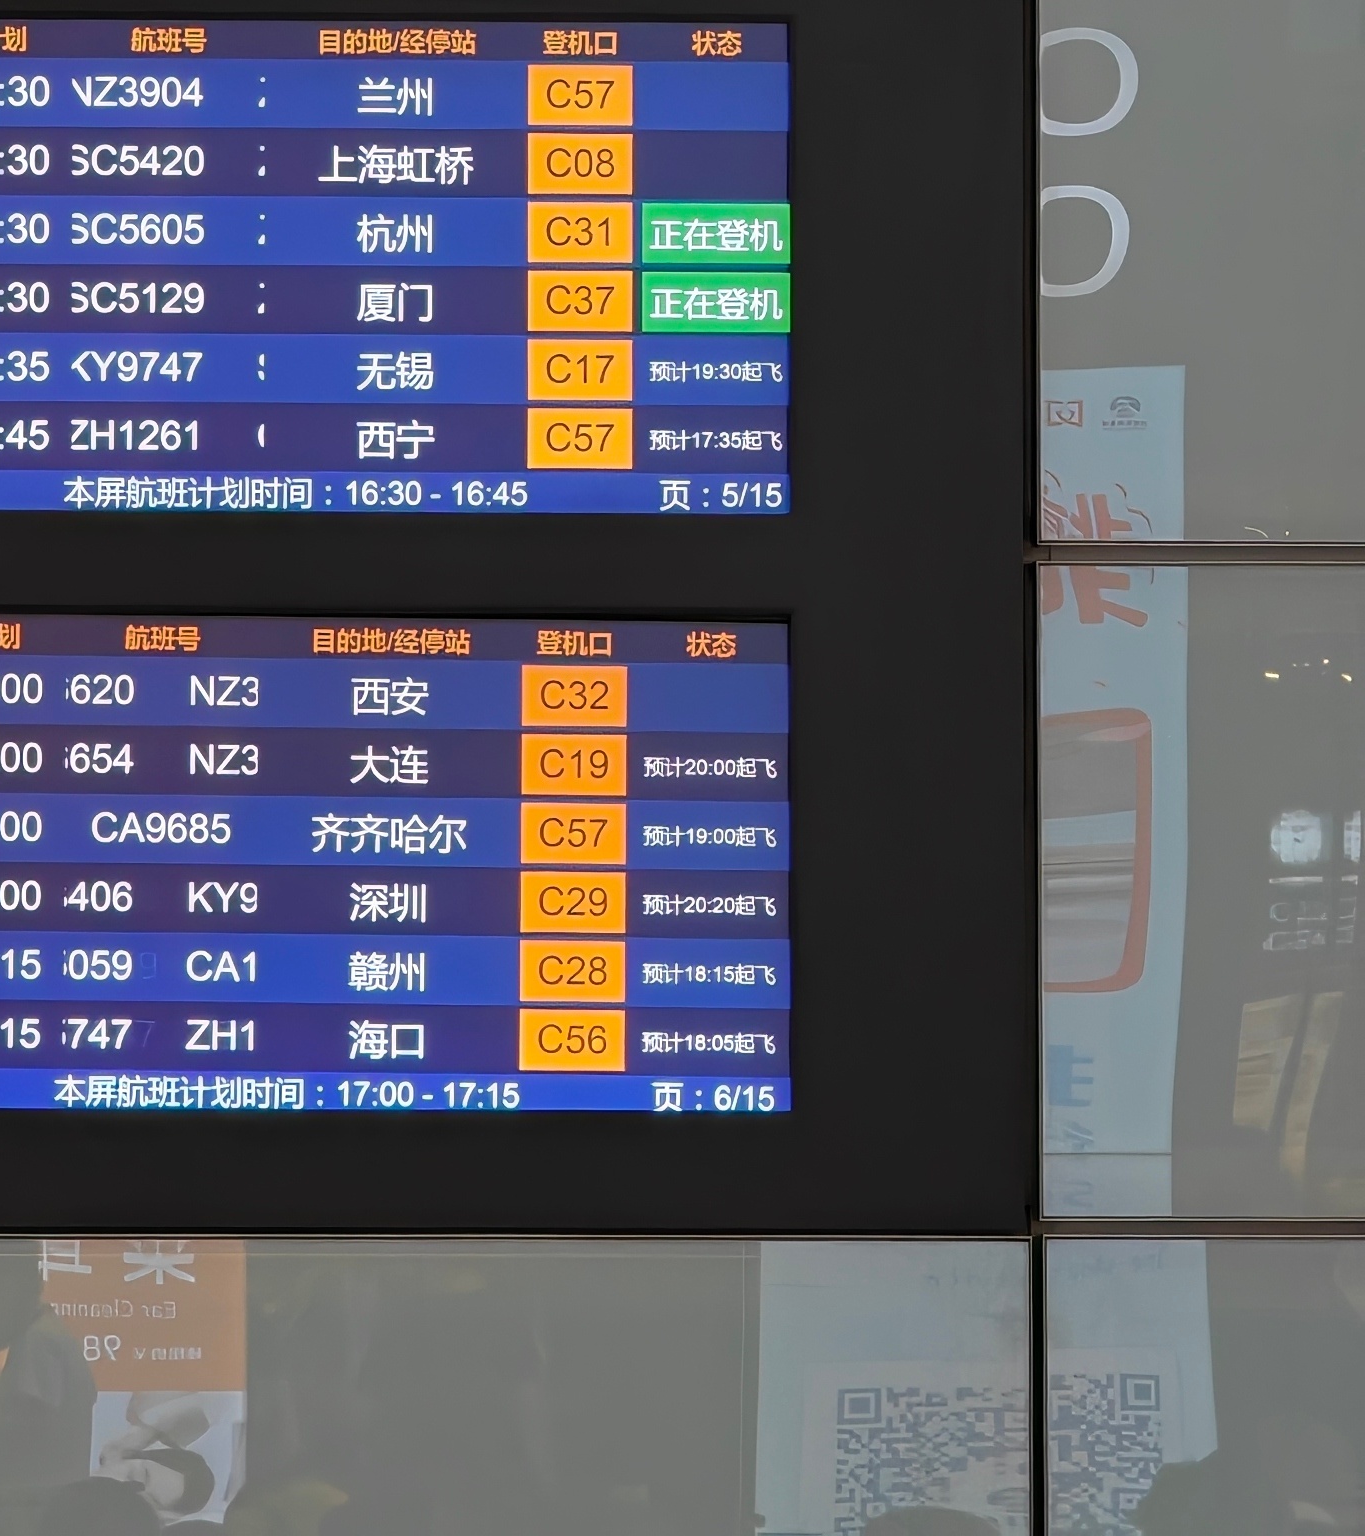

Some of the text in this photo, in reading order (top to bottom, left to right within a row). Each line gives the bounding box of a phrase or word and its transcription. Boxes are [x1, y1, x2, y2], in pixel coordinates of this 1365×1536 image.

[131, 28, 205, 53] 航班号
[320, 29, 475, 53] 目的地/经停站
[544, 31, 617, 54] 登机口
[693, 31, 741, 56] 状态
[357, 214, 432, 253] 杭州
[547, 217, 609, 246] C31
[650, 218, 783, 251] 正在登机
[357, 283, 432, 322] 厦门
[547, 285, 614, 315] C37
[650, 287, 783, 320] 正在登机
[357, 352, 433, 390] 无锡
[547, 354, 614, 383] C17
[650, 361, 783, 382] 预计19:30起飞
[125, 625, 201, 651] 航班号
[314, 628, 469, 655] 目的地/经停站
[538, 631, 611, 656] 登机口
[688, 632, 735, 656] 状态
[350, 745, 428, 784] 大连
[540, 749, 608, 778] C19
[644, 757, 777, 778] 预计20:00起飞
[92, 812, 230, 843] CA9685
[312, 813, 466, 854] 齐齐哈尔
[540, 818, 607, 847] C57
[643, 826, 776, 847] 预计19:00起飞
[350, 883, 426, 923] 深圳
[539, 886, 607, 916] C29
[643, 894, 776, 916] 预计20:20起飞
[348, 951, 424, 991] 赣州
[539, 955, 606, 985] C28
[643, 963, 776, 985] 预计18:15起飞
